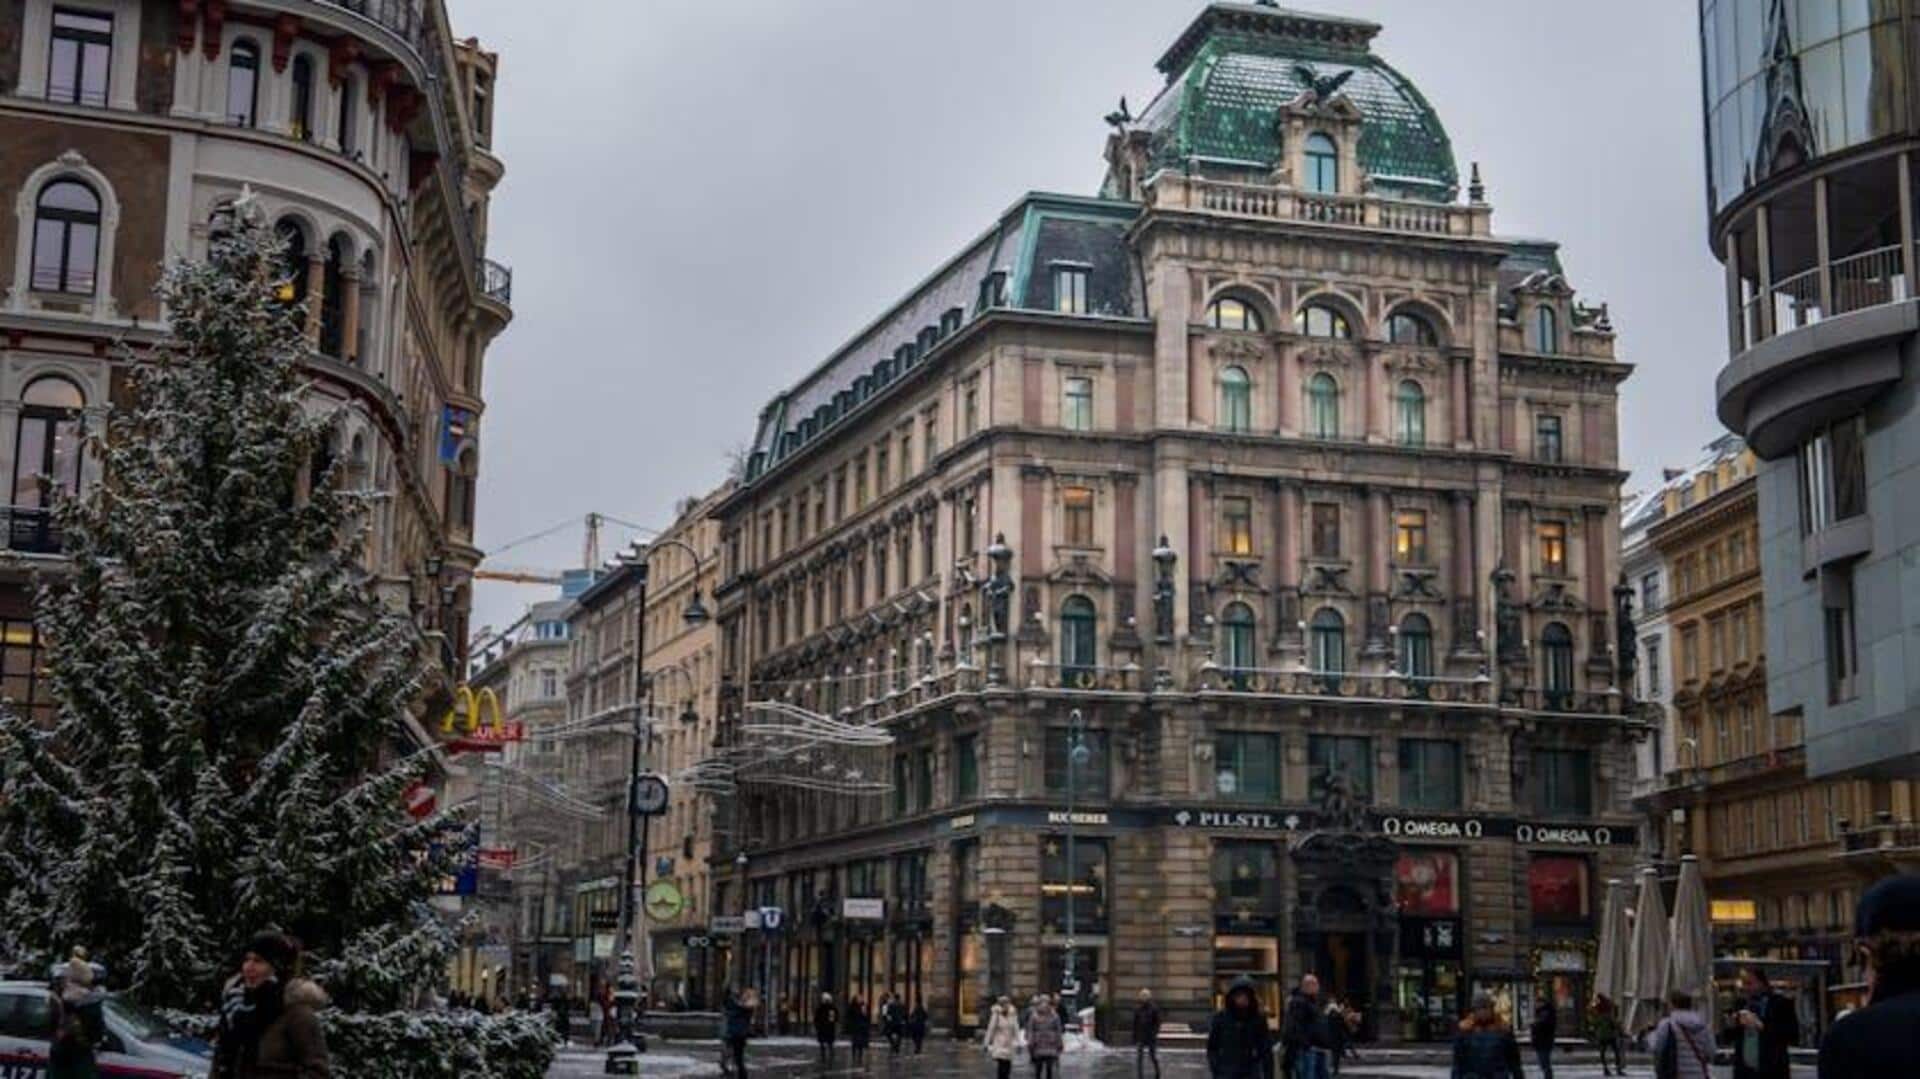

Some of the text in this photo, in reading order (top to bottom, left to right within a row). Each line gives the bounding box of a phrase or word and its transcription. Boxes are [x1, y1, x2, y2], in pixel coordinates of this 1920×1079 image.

[1199, 811, 1278, 828] PILSTL
[1404, 820, 1461, 836] OMEGA
[1536, 828, 1591, 843] OMEGA
